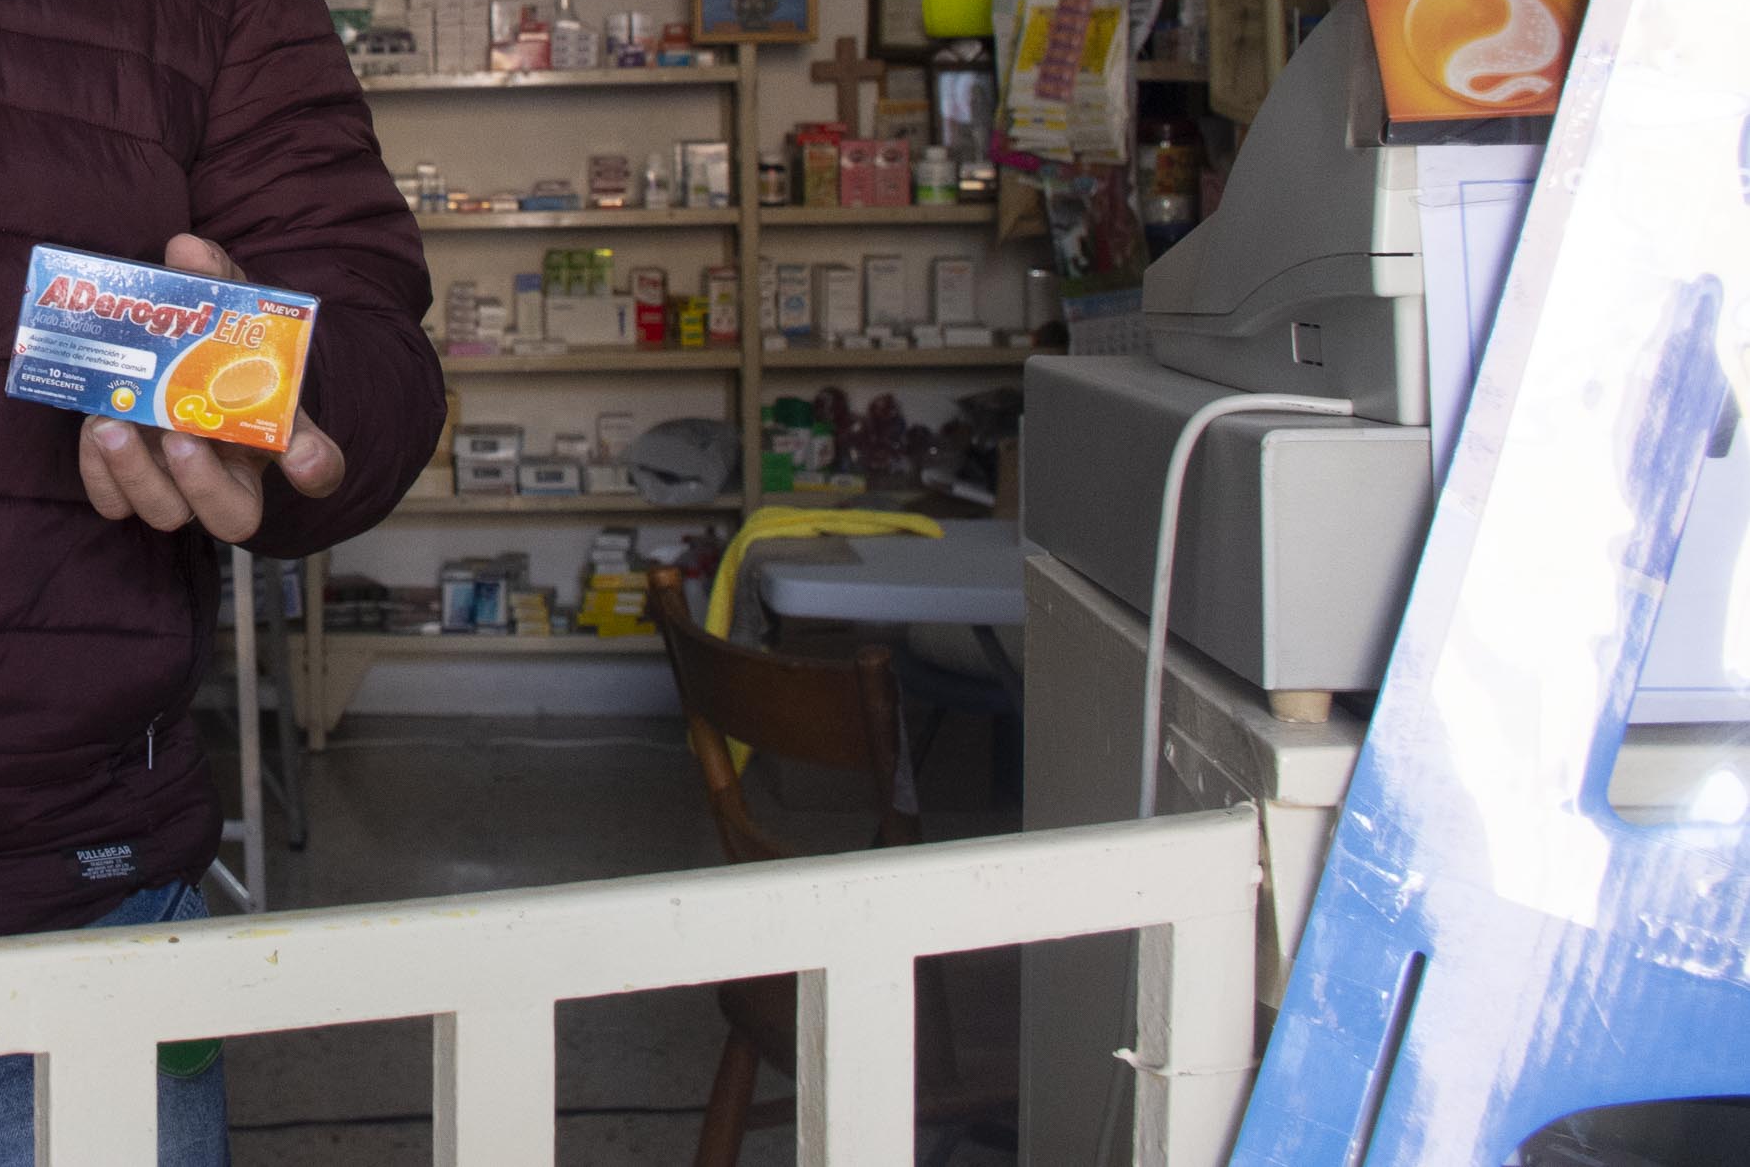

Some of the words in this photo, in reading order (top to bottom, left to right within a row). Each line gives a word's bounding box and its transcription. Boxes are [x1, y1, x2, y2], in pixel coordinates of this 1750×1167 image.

[37, 274, 215, 340] ADerogyl
[212, 309, 266, 350] Efe
[262, 301, 301, 318] NUEVO
[29, 334, 58, 346] Auxiliar
[58, 340, 69, 348] en
[70, 342, 77, 350] la
[78, 344, 120, 359] prevención
[72, 352, 85, 360] del
[85, 354, 120, 368] resfriado
[121, 362, 147, 374] común
[48, 368, 62, 378] 10
[21, 372, 86, 392] EFERVESCENTES
[106, 379, 142, 397] Vitamina
[116, 391, 127, 407] C
[264, 432, 275, 444] 1g
[76, 845, 132, 861] PULL&BEAR
